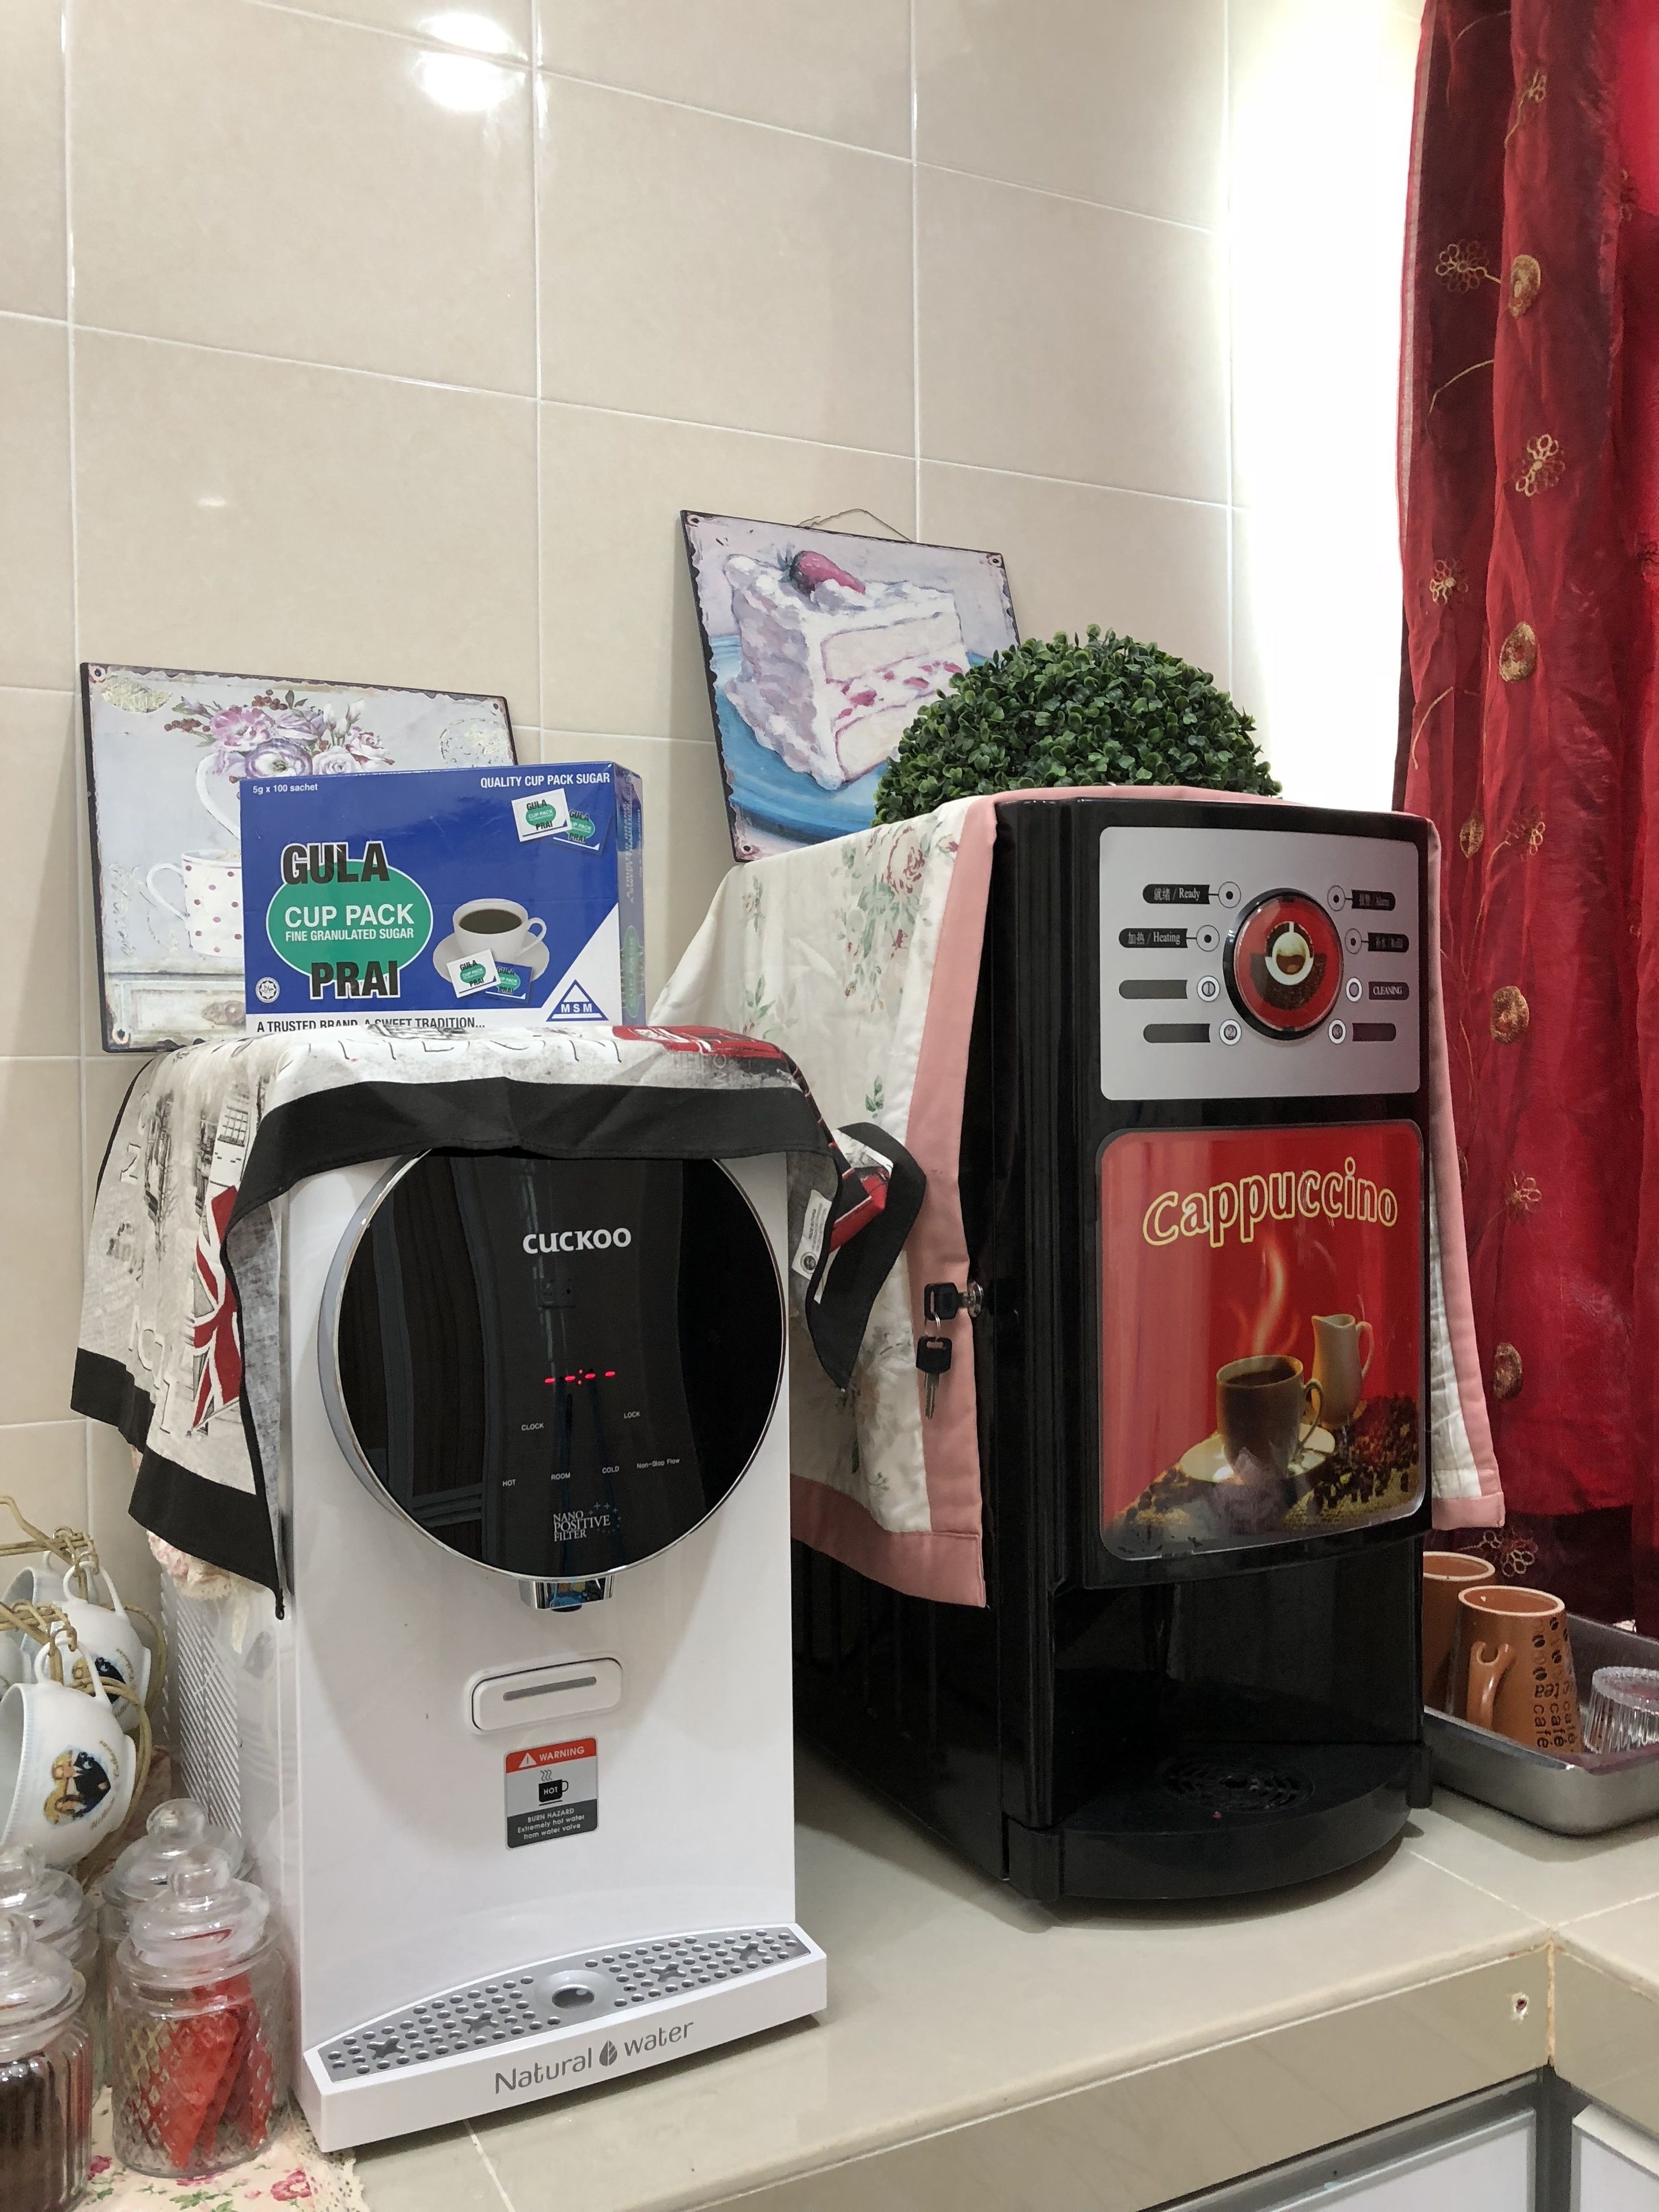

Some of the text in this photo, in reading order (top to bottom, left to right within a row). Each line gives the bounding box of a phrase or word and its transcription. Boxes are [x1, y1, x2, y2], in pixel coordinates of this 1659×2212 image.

[480, 772, 611, 789] QUALITY CUP PACK SUGAR
[252, 785, 264, 795] 5g
[273, 784, 288, 793] 100
[290, 783, 318, 791] sachet
[527, 799, 547, 811] GULA
[540, 809, 554, 817] PACK
[569, 809, 589, 822] GULA
[535, 820, 553, 831] PRAI
[569, 832, 586, 843] PRAI
[282, 842, 390, 885] GULA
[1153, 887, 1171, 902] 就绪
[1179, 887, 1200, 902] Ready
[285, 903, 415, 928] CUP PACK
[285, 927, 414, 942] FINE GRANULATED SUGAR
[1127, 931, 1145, 945] 加热
[1153, 931, 1181, 945] Heating
[459, 960, 478, 971] GULA
[310, 960, 400, 999] PRAI
[469, 977, 484, 987] PRAI
[1373, 986, 1403, 995] CLEANING
[257, 1021, 265, 1032] A
[267, 1020, 317, 1032] TRUSTED
[1142, 1156, 1398, 1248] Cappuccino
[522, 1227, 632, 1255] CUCKOO
[623, 1411, 641, 1419] LOCK
[521, 1422, 544, 1431] CLOCK
[602, 1465, 619, 1474] COLD
[502, 1479, 516, 1487] HOT
[551, 1472, 571, 1481] ROOM
[553, 1510, 584, 1522] NANO
[554, 1514, 611, 1533] POSITIVE
[554, 1529, 587, 1542] FILTER
[539, 1746, 585, 1762] WARNING
[543, 1786, 558, 1796] HOT
[527, 1808, 575, 1823] BURN HAZARD
[517, 1815, 585, 1834] Extremely hot water
[524, 1823, 581, 1840] from water valve
[495, 2021, 694, 2094] Natural water
